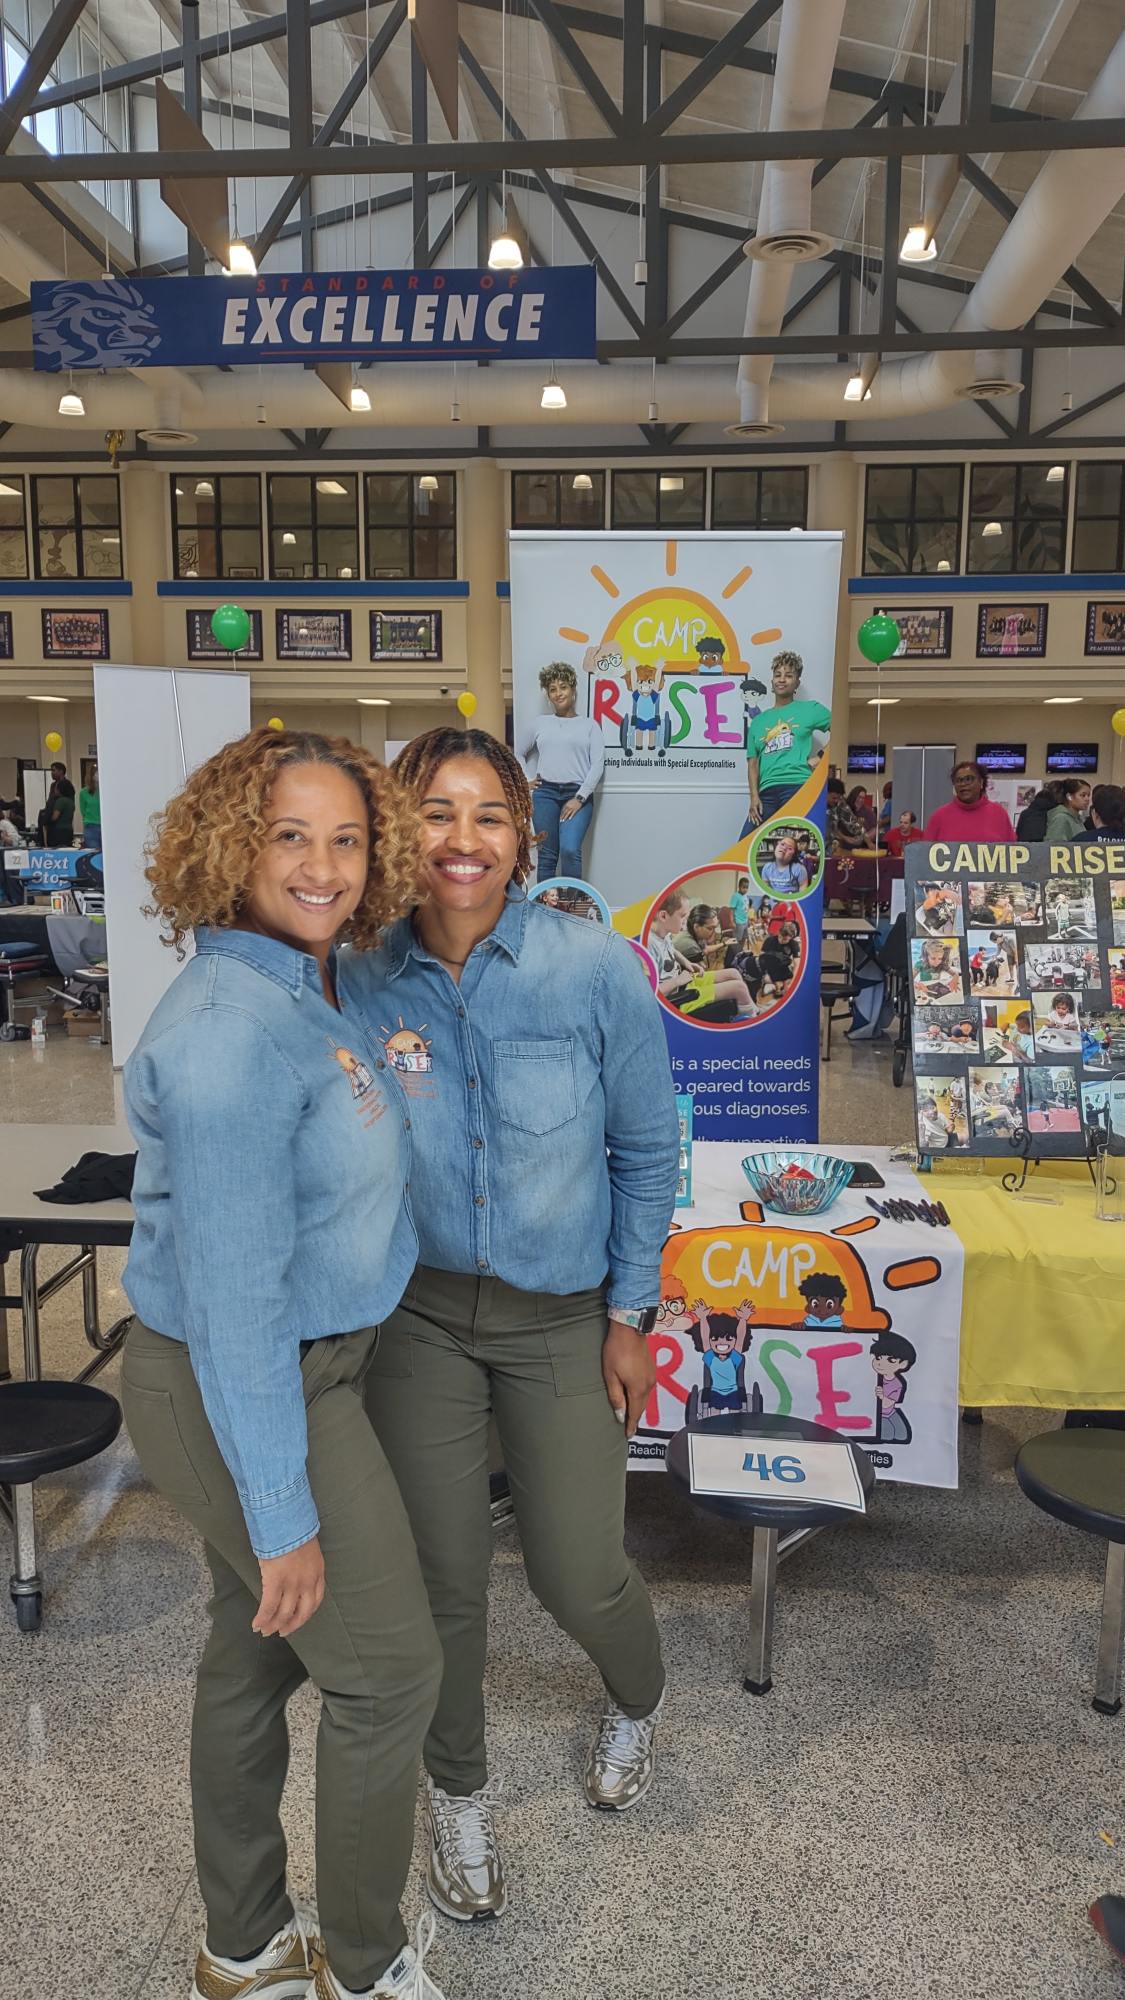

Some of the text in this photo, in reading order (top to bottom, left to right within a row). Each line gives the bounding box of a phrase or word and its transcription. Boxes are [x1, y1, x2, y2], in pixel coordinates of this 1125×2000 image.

[256, 275, 520, 293] STANDARD OF
[221, 294, 545, 345] EXCELLENCE
[633, 615, 706, 655] CAMP
[593, 678, 742, 745] RSE
[621, 758, 653, 767] Individuals
[653, 758, 667, 767] with
[667, 759, 689, 769] Special
[690, 759, 736, 770] Exceptionalities
[31, 856, 69, 869] Next
[929, 843, 1125, 875] CAMP RISE
[32, 871, 69, 887] Stop
[387, 1052, 427, 1071] RSE
[672, 1056, 811, 1073] is a special needs
[686, 1079, 743, 1096] geared
[748, 1079, 811, 1093] towards
[726, 1102, 810, 1118] diagnoses.
[702, 1241, 816, 1298] CAMP
[645, 1333, 872, 1429] RSE
[742, 1453, 806, 1483] 46
[391, 1957, 406, 1981] NIKE
